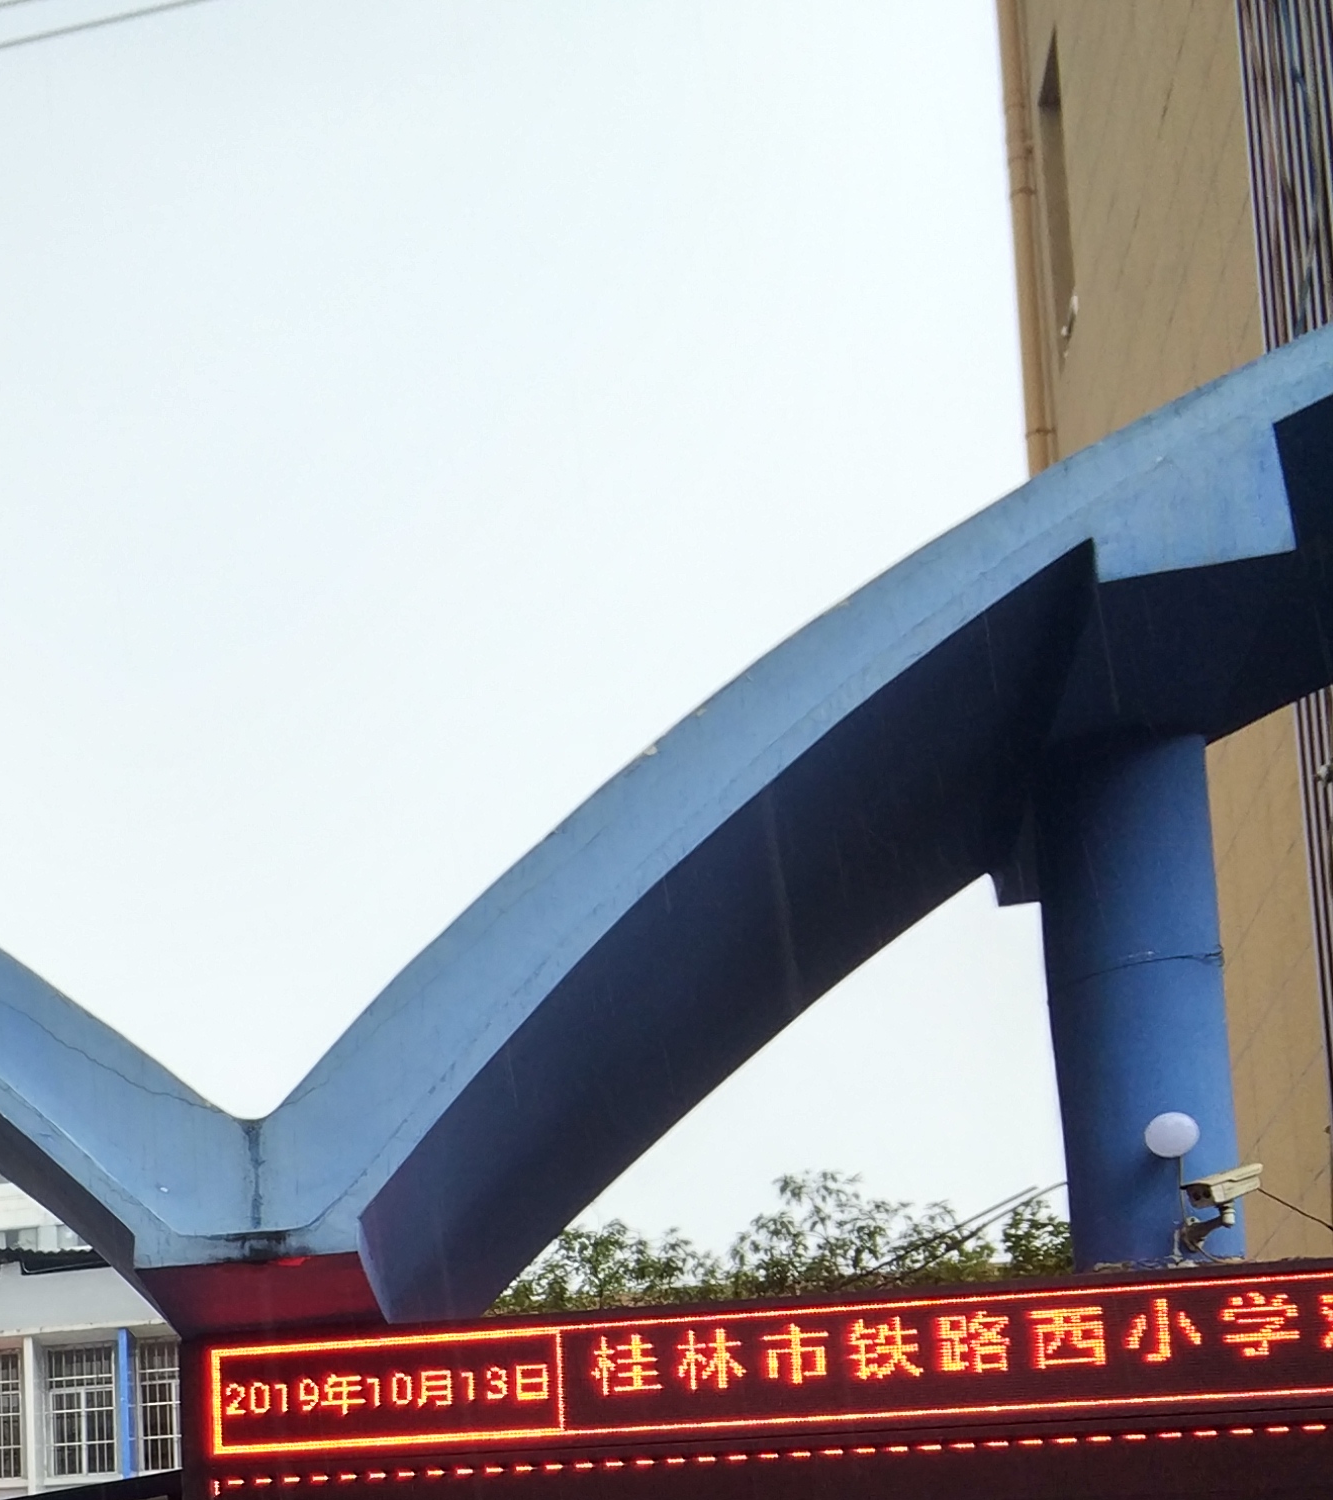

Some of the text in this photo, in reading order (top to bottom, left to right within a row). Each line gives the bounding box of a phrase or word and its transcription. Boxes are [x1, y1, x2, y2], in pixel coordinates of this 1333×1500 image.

[592, 1292, 1333, 1396] 桂林市铁路西小学
[224, 1362, 550, 1417] 2019年10月13日
